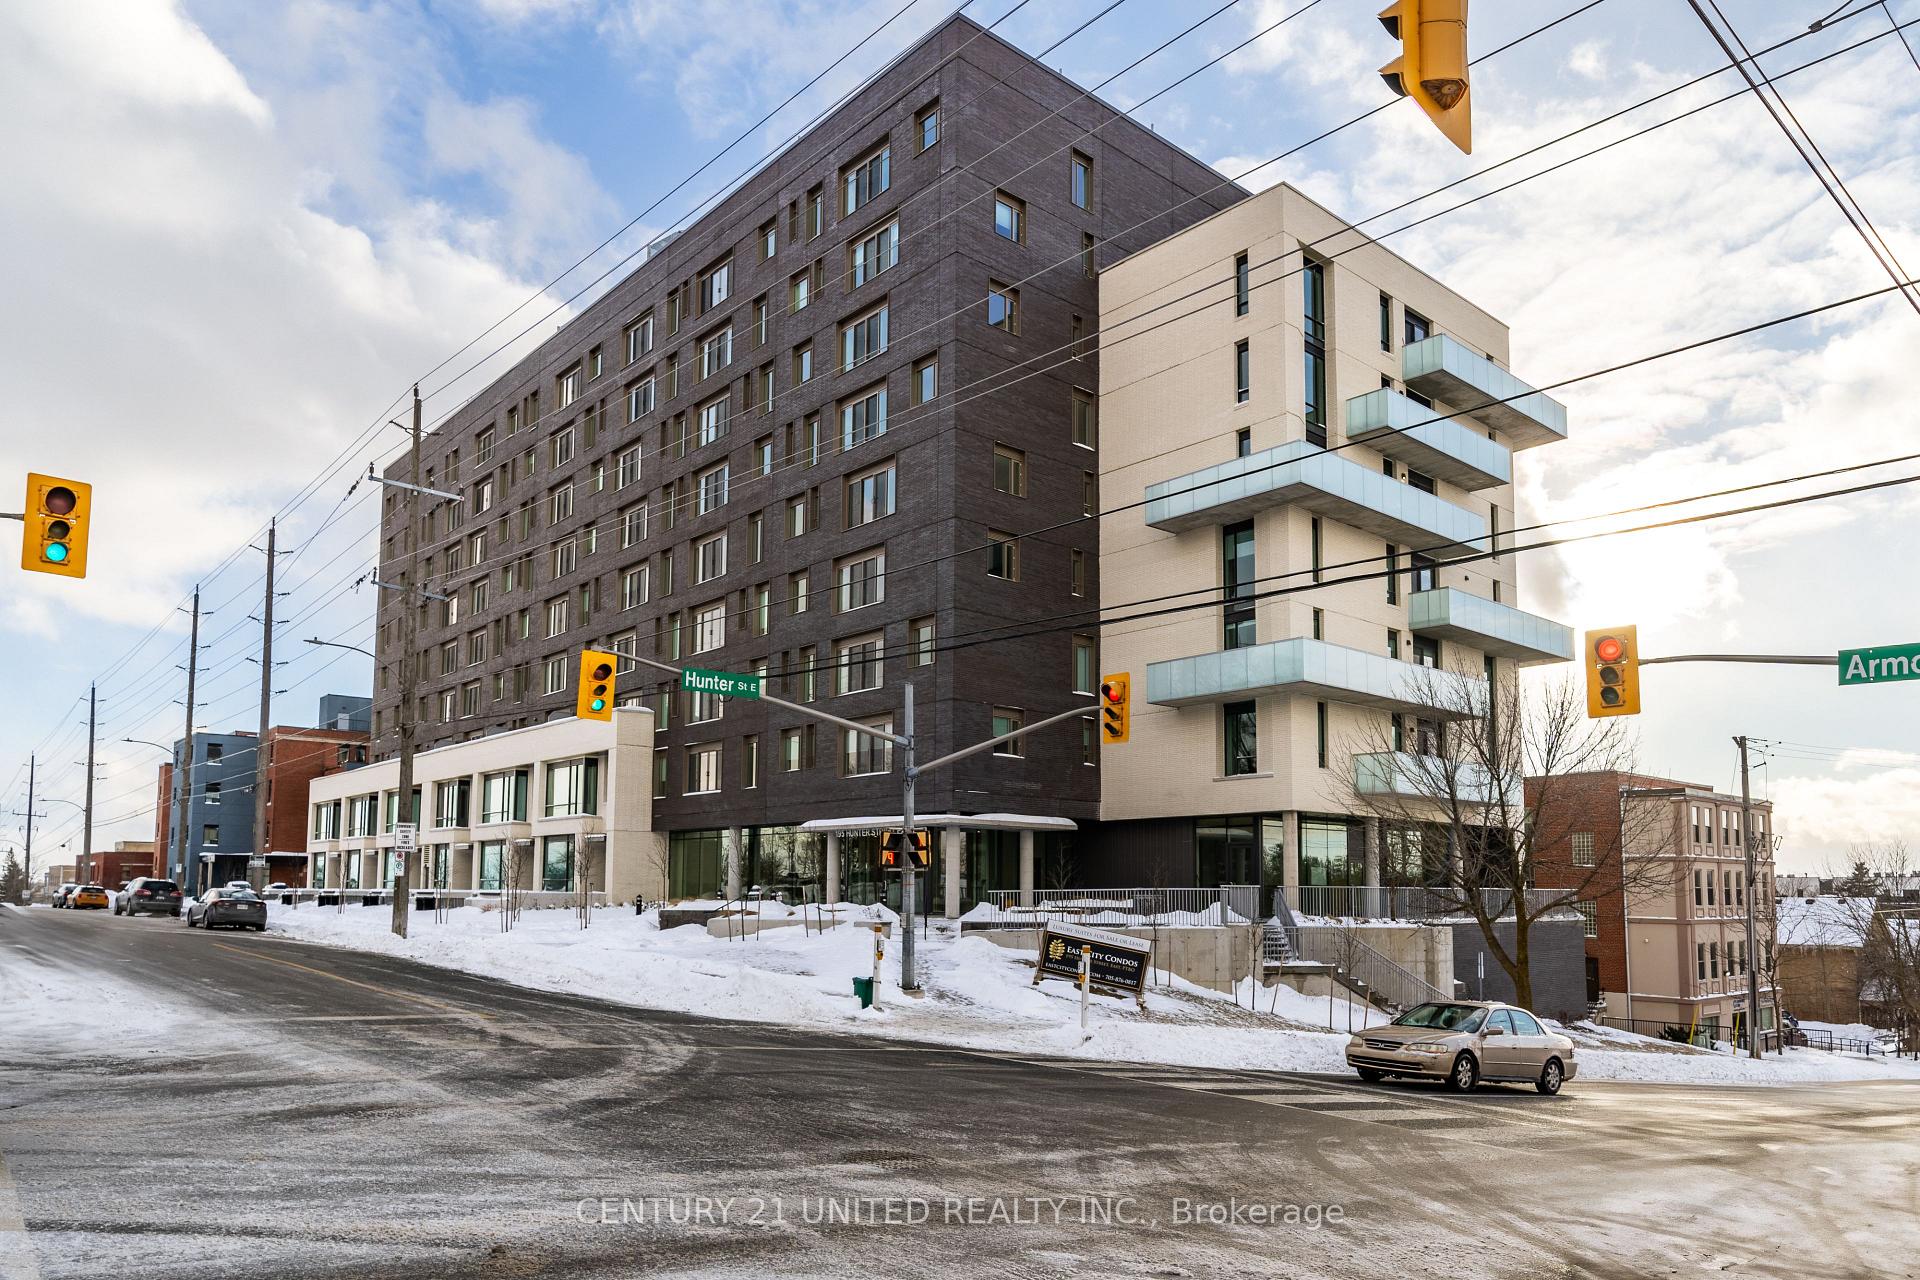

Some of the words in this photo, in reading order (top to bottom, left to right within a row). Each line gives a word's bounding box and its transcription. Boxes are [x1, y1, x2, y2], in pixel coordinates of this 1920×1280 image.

[685, 671, 734, 692] Hunter
[737, 681, 748, 691] St
[750, 683, 757, 692] E
[846, 829, 870, 837] HUNTER
[1106, 935, 1119, 943] SALE
[1090, 950, 1105, 960] ITY
[1105, 954, 1139, 968] CONDOS
